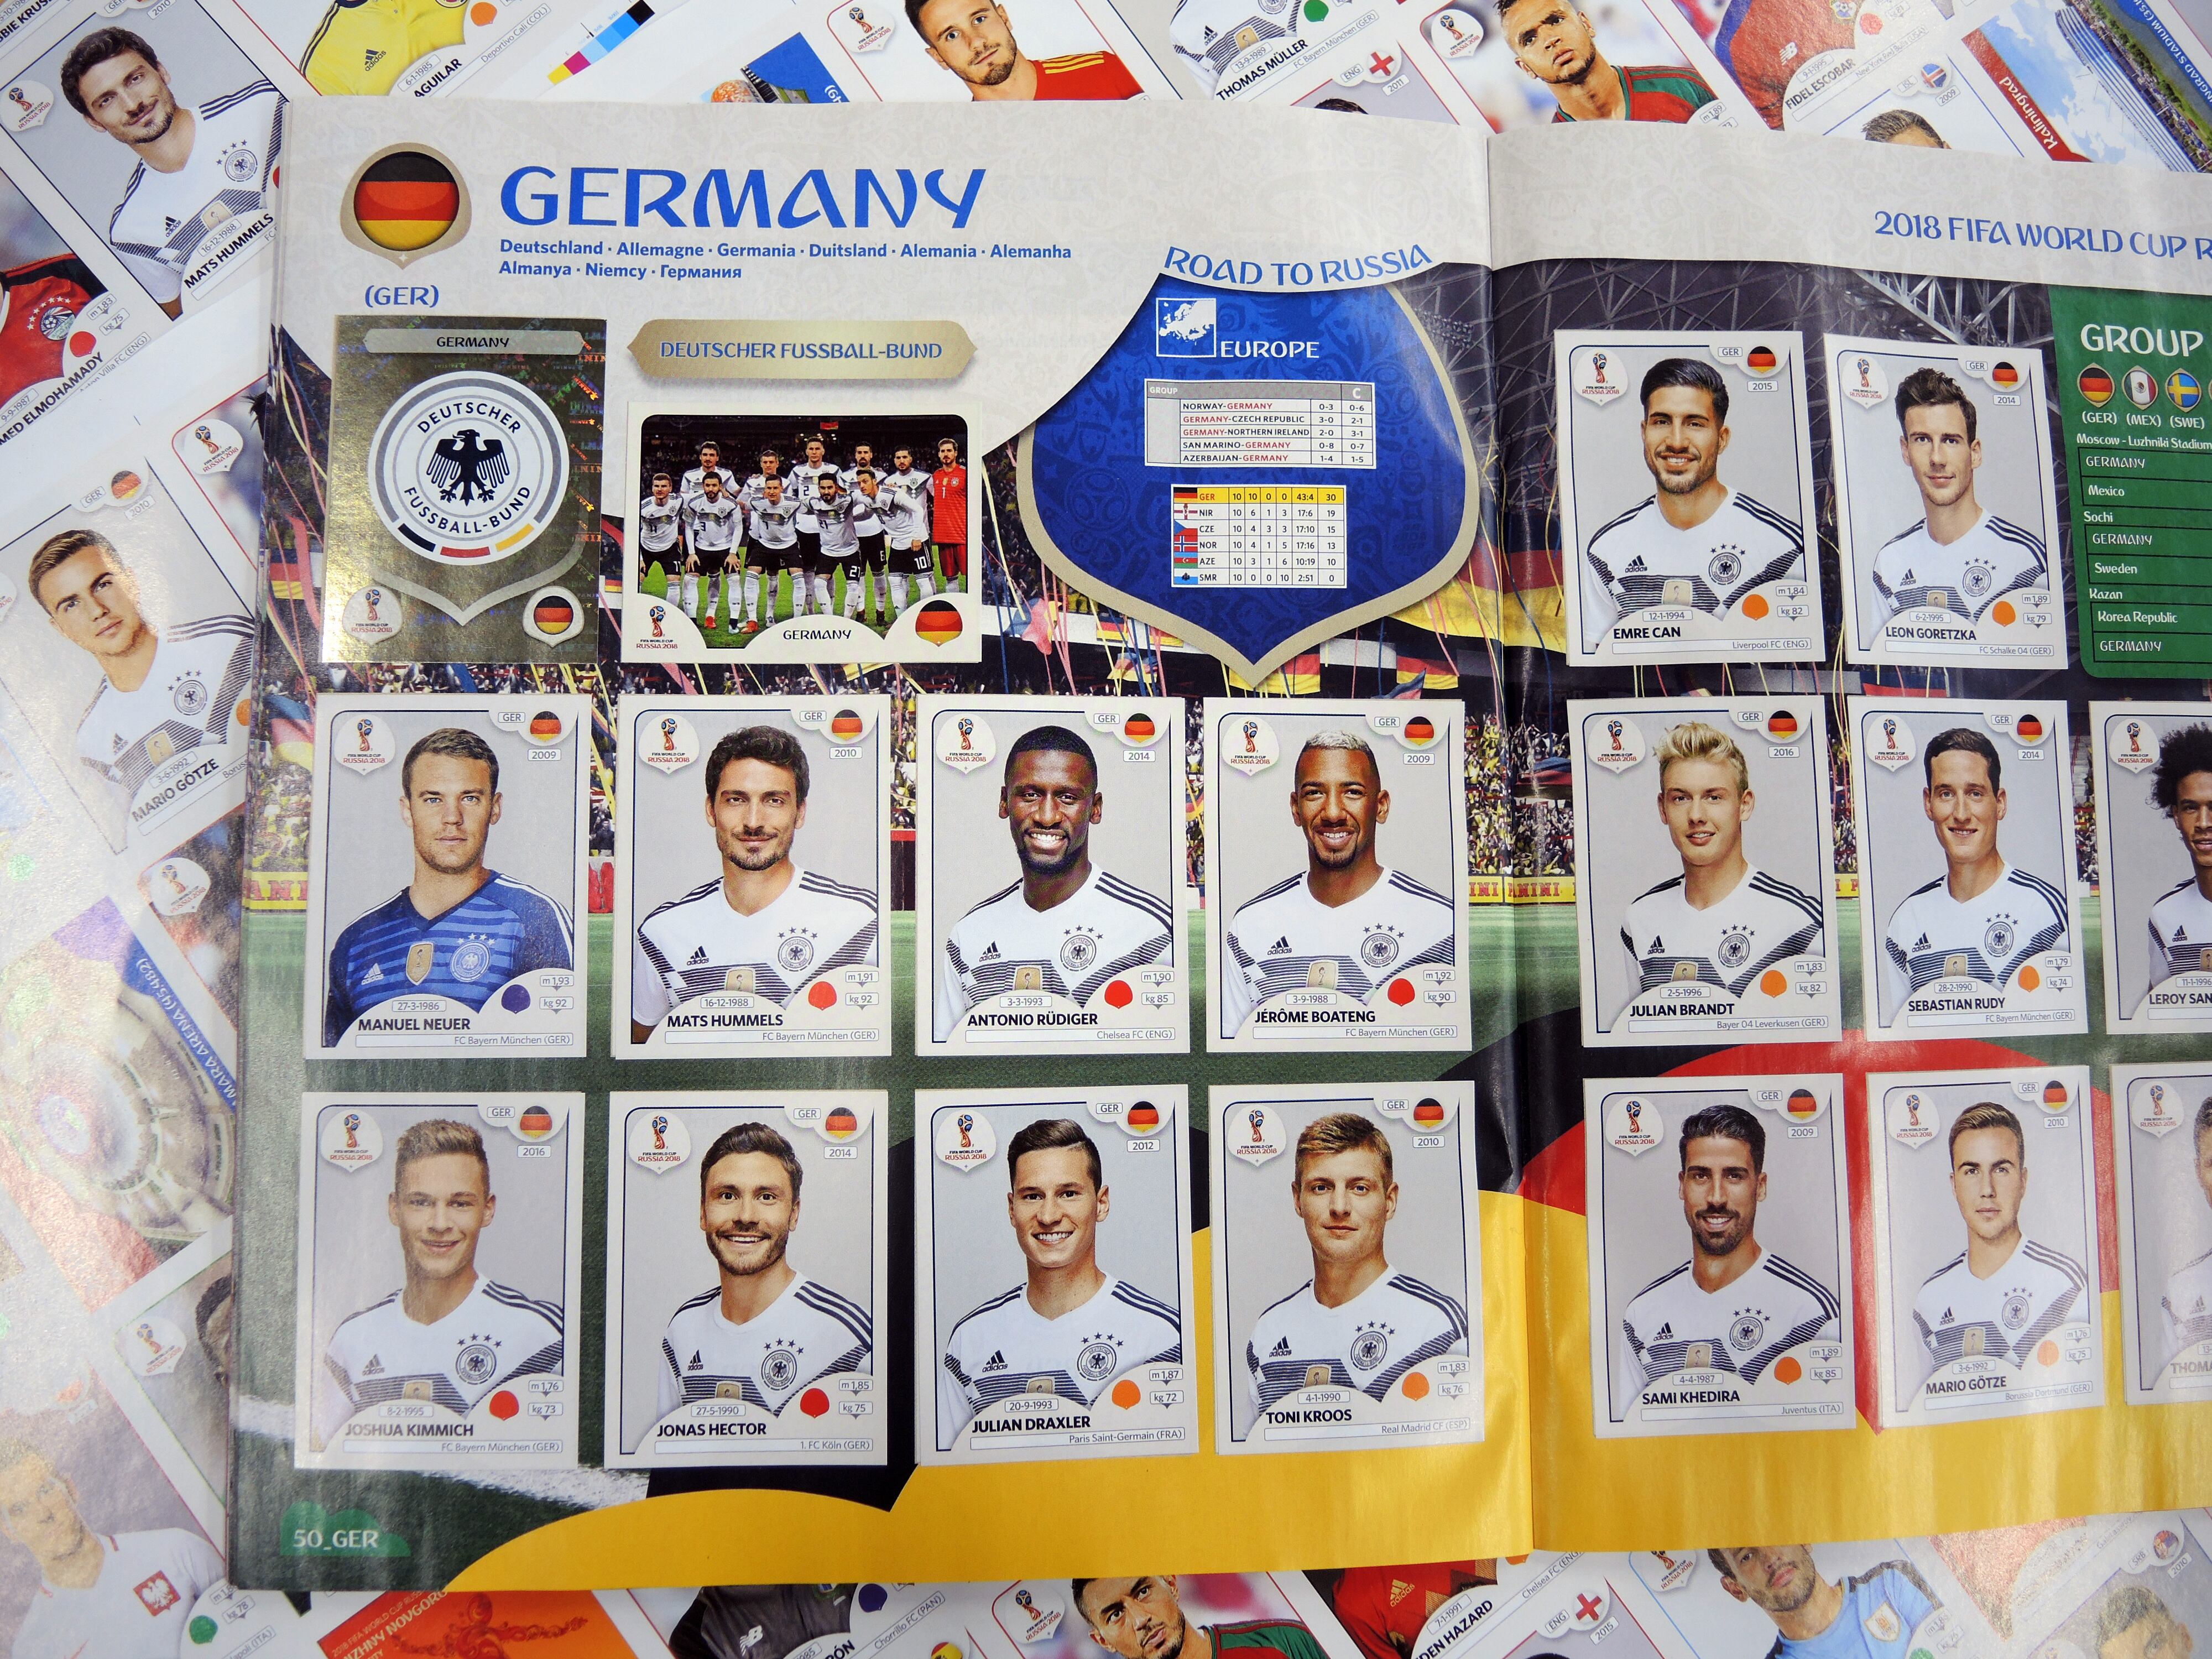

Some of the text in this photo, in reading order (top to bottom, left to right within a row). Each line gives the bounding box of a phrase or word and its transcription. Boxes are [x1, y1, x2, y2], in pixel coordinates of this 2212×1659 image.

[481, 7, 547, 63] Deportivo Cali (COL)
[1216, 39, 1308, 101] THOMAS MÜLLER
[1344, 66, 1360, 80] ENG
[414, 59, 462, 97] AGUILAR
[1785, 59, 1855, 109] FIDEL ESCOBAR
[1387, 79, 1404, 93] 2011
[1939, 88, 1956, 104] 2009
[1999, 76, 2058, 149] Kaliningrad
[500, 166, 987, 228] GERMANY
[1875, 211, 1942, 239] 2018
[1949, 217, 2011, 246] FIFA
[2016, 223, 2123, 253] WORLD
[2130, 232, 2187, 258] CUP
[184, 213, 274, 288] MATS HUMMELS
[500, 240, 1071, 258] Deutschland Allemagne Germania Duitsland Alemania Alemanha
[499, 261, 646, 279] Almanya Niemcy
[660, 265, 742, 280] Германия
[1164, 244, 1433, 286] ROAD TO RUSSIA
[364, 285, 439, 308] (GER)
[436, 336, 509, 348] GERMANY
[2080, 324, 2204, 357] GROUP
[660, 342, 942, 359] DEUTSCHER FUSSBALL-BUND
[1220, 341, 1319, 359] EUROPE
[23, 352, 103, 424] ELMOHAMADY
[1353, 388, 1360, 398] C
[417, 402, 521, 434] DEUTSCHER
[2082, 411, 2205, 429] (GER) (MEX) (SWE)
[2077, 434, 2212, 450] Moscow Luzhniki Stadium
[1183, 454, 1288, 462] AZERBAIJAN-GERMANY
[2086, 457, 2145, 468] GERMANY
[2089, 485, 2125, 497] Mexico
[404, 487, 530, 534] FUSSBALL-BUND
[2084, 512, 2113, 522] Sochi
[2092, 534, 2152, 546] GERMANY
[2095, 563, 2137, 574] Sweden
[2089, 588, 2122, 599] Kazan
[1649, 612, 1685, 620] 12-1-1994
[2098, 611, 2178, 624] Korea Republic
[783, 629, 851, 640] GERMANY
[1614, 627, 1681, 639] EMRE CAN
[1886, 627, 1976, 640] LEON GORETZKA
[2100, 640, 2162, 653] GERMANY
[132, 759, 219, 822] MARIO GÖTZE
[1938, 982, 1973, 992] 28-2-1990
[398, 1001, 439, 1010] 27-3-1986
[1293, 995, 1328, 1003] 3-9-1988
[1908, 998, 2005, 1012] SEBASTIAN RUDY
[2149, 994, 2187, 1004] LEROY
[136, 959, 208, 1055] ARENA (45.482)
[1630, 1003, 1734, 1017] JULIAN BRANDT
[667, 1014, 783, 1027] MATS HUMMELS
[968, 1011, 1098, 1026] ANTONIO RÜDIGER
[1255, 1009, 1375, 1023] JÉRÔME BOATENG
[358, 1019, 471, 1030] MANUEL NEUER
[1679, 1375, 1715, 1384] 4-4-1987
[1926, 1376, 2006, 1395] MARIO GÖTZE
[1642, 1390, 1740, 1405] SAMI KHEDIRA
[1009, 1401, 1052, 1410] 20-9-1993
[1781, 1404, 1840, 1415] Juventus (ITA)
[972, 1415, 1091, 1433] JULIAN DRAXLER
[1266, 1409, 1352, 1424] TONI KROOS
[345, 1424, 473, 1437] JOSHUA KIMMICH
[657, 1423, 766, 1437] JONAS HECTOR
[1069, 1430, 1182, 1443] Paris Saint-Germain (FRA)
[293, 1530, 379, 1550] 50_GER
[874, 1595, 942, 1650] Chorrillo FC (PAN)
[1444, 1600, 1493, 1640] HAZARD
[1548, 1614, 1566, 1630] ENG
[1595, 1623, 1614, 1640] 2015
